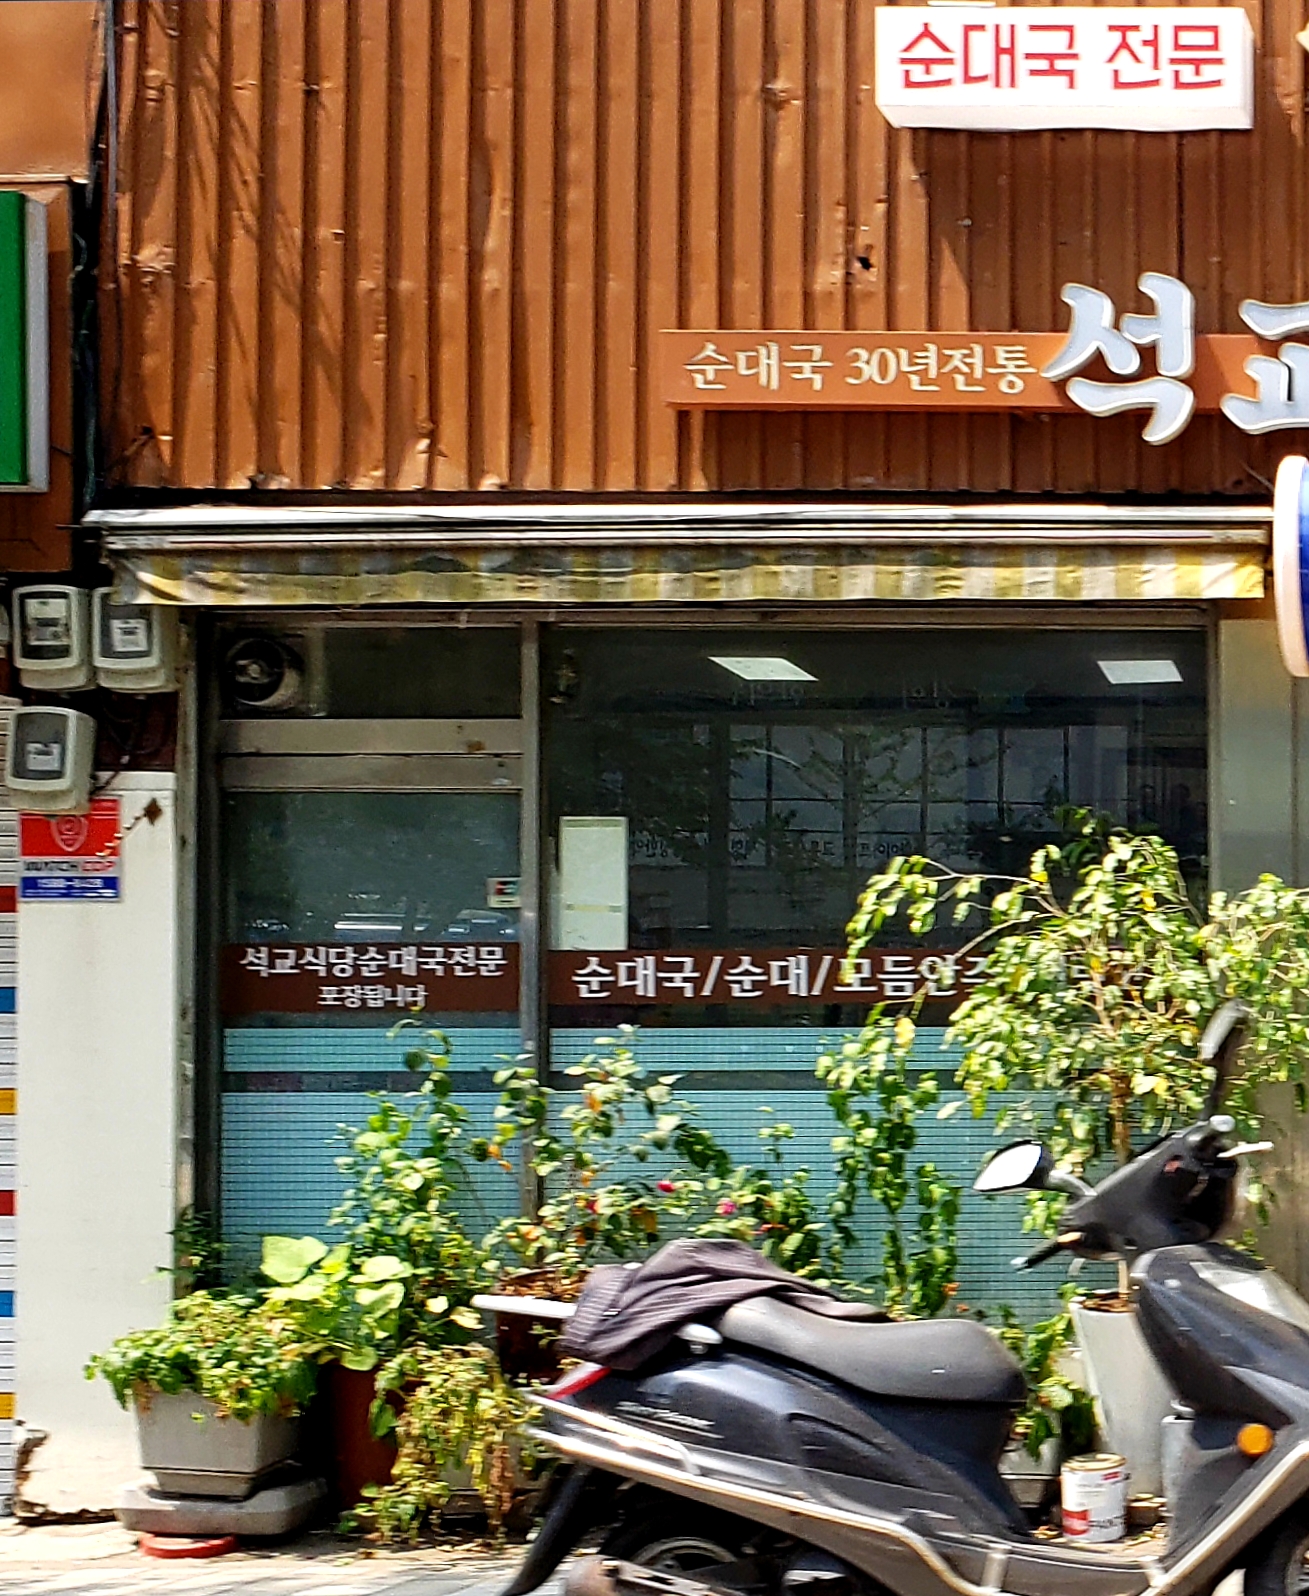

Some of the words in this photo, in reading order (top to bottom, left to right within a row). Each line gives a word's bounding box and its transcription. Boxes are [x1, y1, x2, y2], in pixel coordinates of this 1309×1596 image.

[898, 22, 1080, 89] 순대국
[1105, 24, 1225, 89] 전문
[683, 341, 834, 391] 순대국
[845, 342, 1038, 394] 30년전통
[239, 946, 508, 977] 석교식당순대국전문
[317, 984, 428, 1009] 포장됩니다
